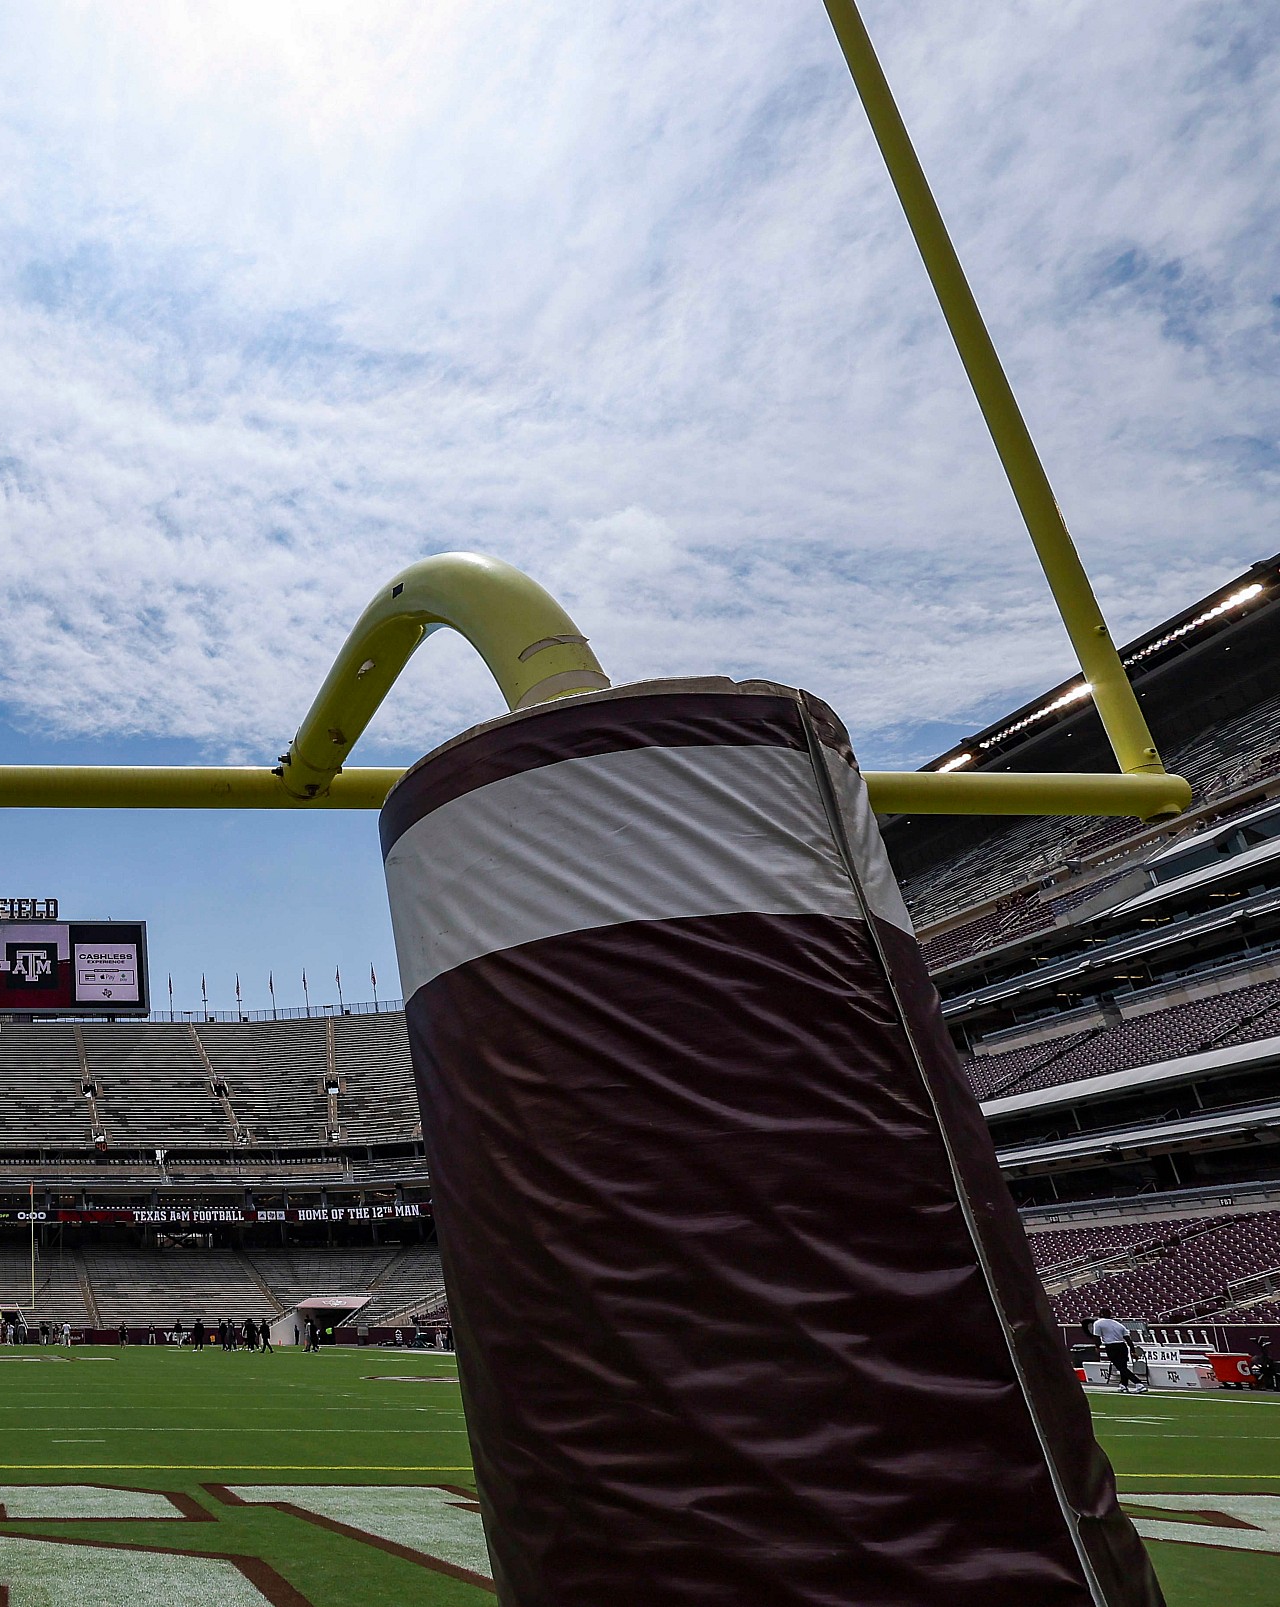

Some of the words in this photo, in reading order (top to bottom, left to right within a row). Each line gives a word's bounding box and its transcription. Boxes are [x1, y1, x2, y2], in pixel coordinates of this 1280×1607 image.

[17, 1211, 46, 1220] 0:00
[133, 1210, 167, 1221] TEXAS
[170, 1210, 190, 1221] A&M
[193, 1210, 244, 1221] FOOTBALL
[297, 1209, 329, 1221] HOME
[331, 1208, 345, 1220] OF
[347, 1206, 370, 1219] THE
[372, 1206, 393, 1218] 12TH
[394, 1204, 420, 1217] MAN
